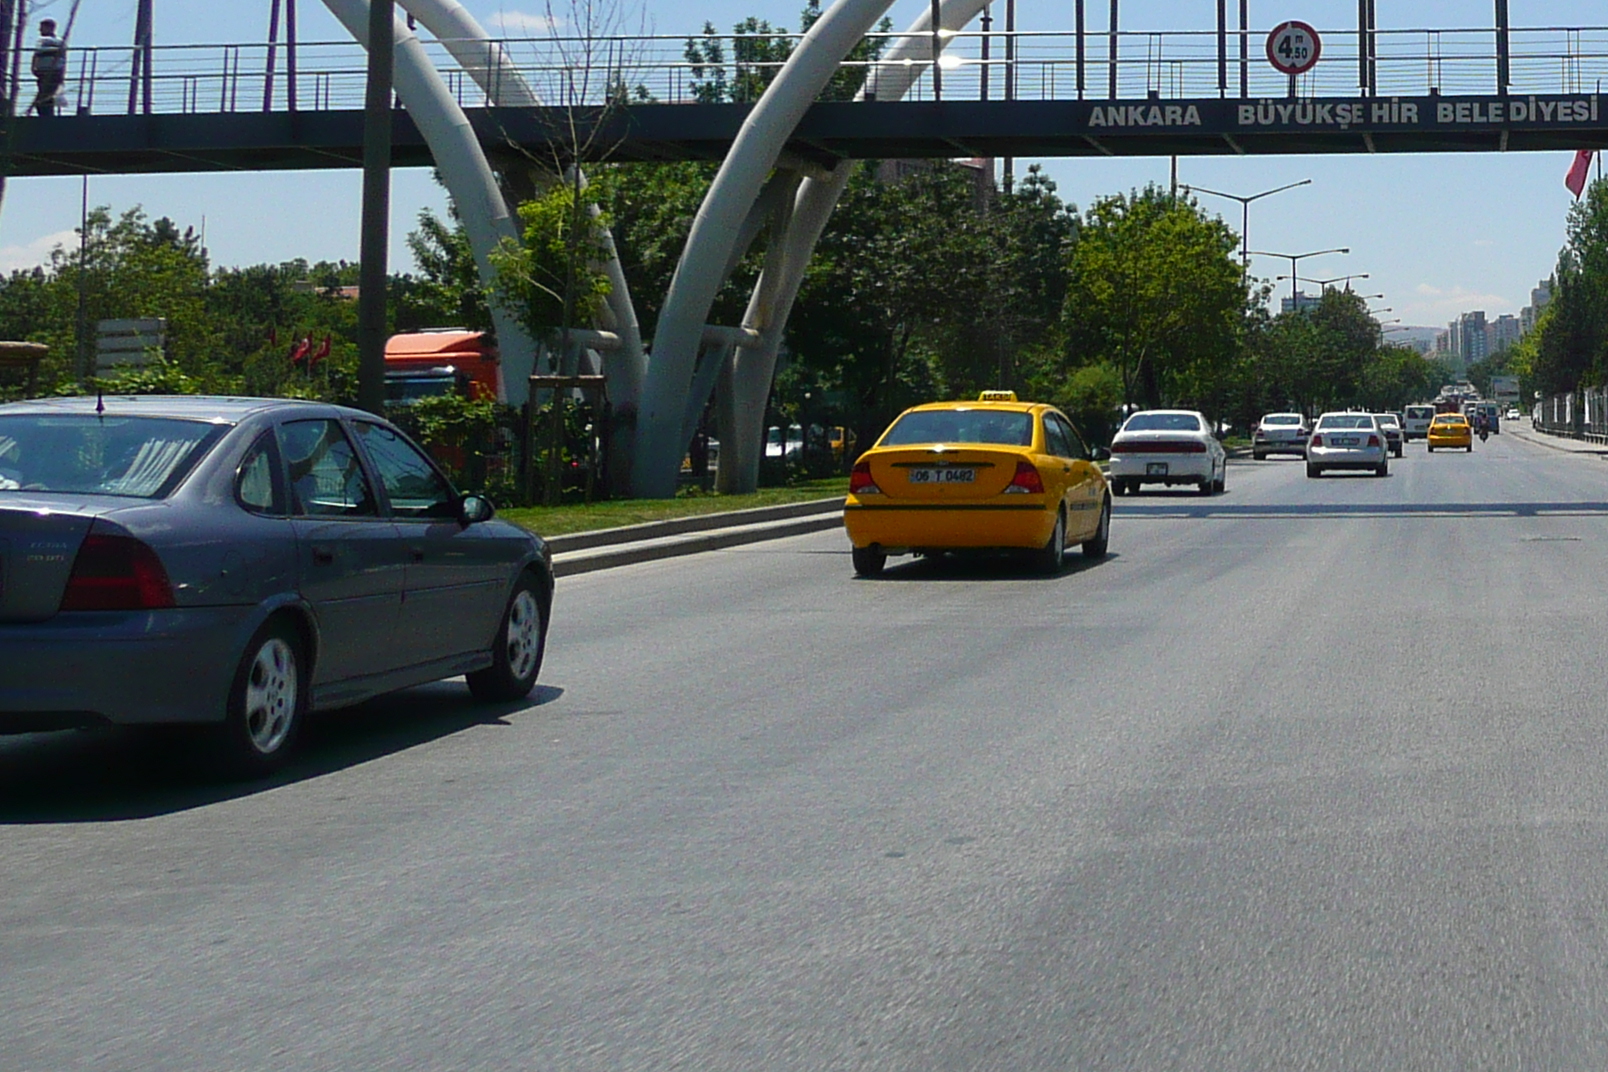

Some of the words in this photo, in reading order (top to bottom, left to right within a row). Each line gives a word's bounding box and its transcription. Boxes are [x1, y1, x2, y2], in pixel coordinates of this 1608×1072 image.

[1088, 105, 1202, 127] ANKARA
[915, 470, 929, 482] 06
[935, 470, 942, 482] T
